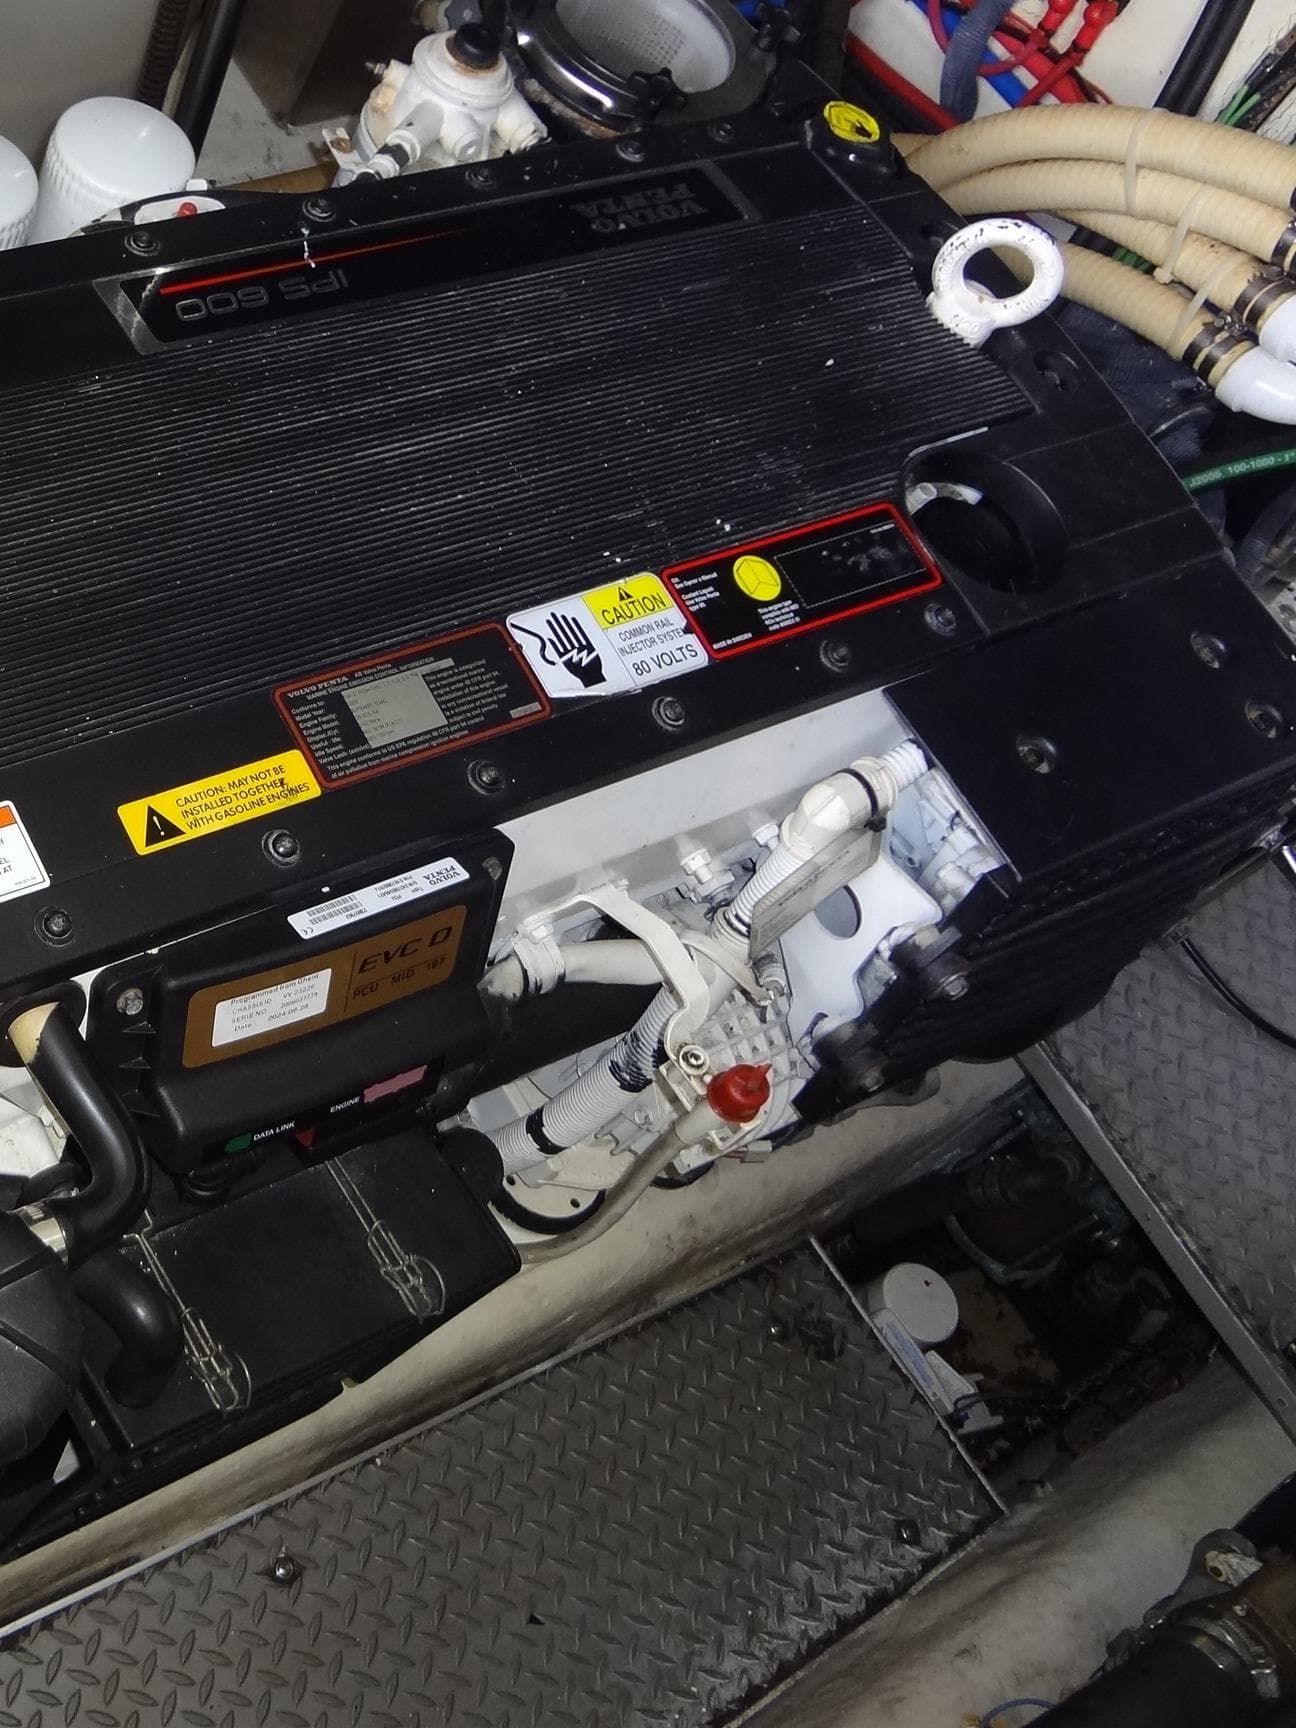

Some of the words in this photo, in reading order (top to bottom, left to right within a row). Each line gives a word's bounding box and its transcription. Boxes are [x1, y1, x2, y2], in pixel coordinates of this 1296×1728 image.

[279, 269, 349, 300] IPS
[176, 286, 269, 322] 600
[602, 592, 666, 625] CAUTION
[619, 624, 654, 642] COMMON
[655, 618, 674, 629] RAIL
[618, 637, 656, 656] INJECTOR
[632, 660, 651, 676] 80
[651, 644, 698, 670] VOLTS
[287, 685, 317, 699] VOLVO
[317, 675, 348, 689] PENTA
[176, 786, 227, 807] CAUTION:
[228, 777, 251, 790] MAY
[250, 768, 272, 783] NOT
[273, 764, 286, 775] BE
[181, 795, 233, 819] INSTALLED
[187, 816, 213, 830] WITH
[215, 797, 266, 821] GASOLINE
[268, 783, 310, 804] ENGINES
[3, 865, 13, 875] AT
[421, 865, 456, 881] PENTA
[427, 870, 460, 885] VOLVO
[358, 938, 422, 974] EVC
[231, 984, 279, 1005] Programmed
[279, 981, 296, 991] from
[353, 982, 379, 999] PCU
[255, 1009, 267, 1017] NO
[254, 1129, 274, 1141] DATA
[276, 1121, 295, 1133] LINK
